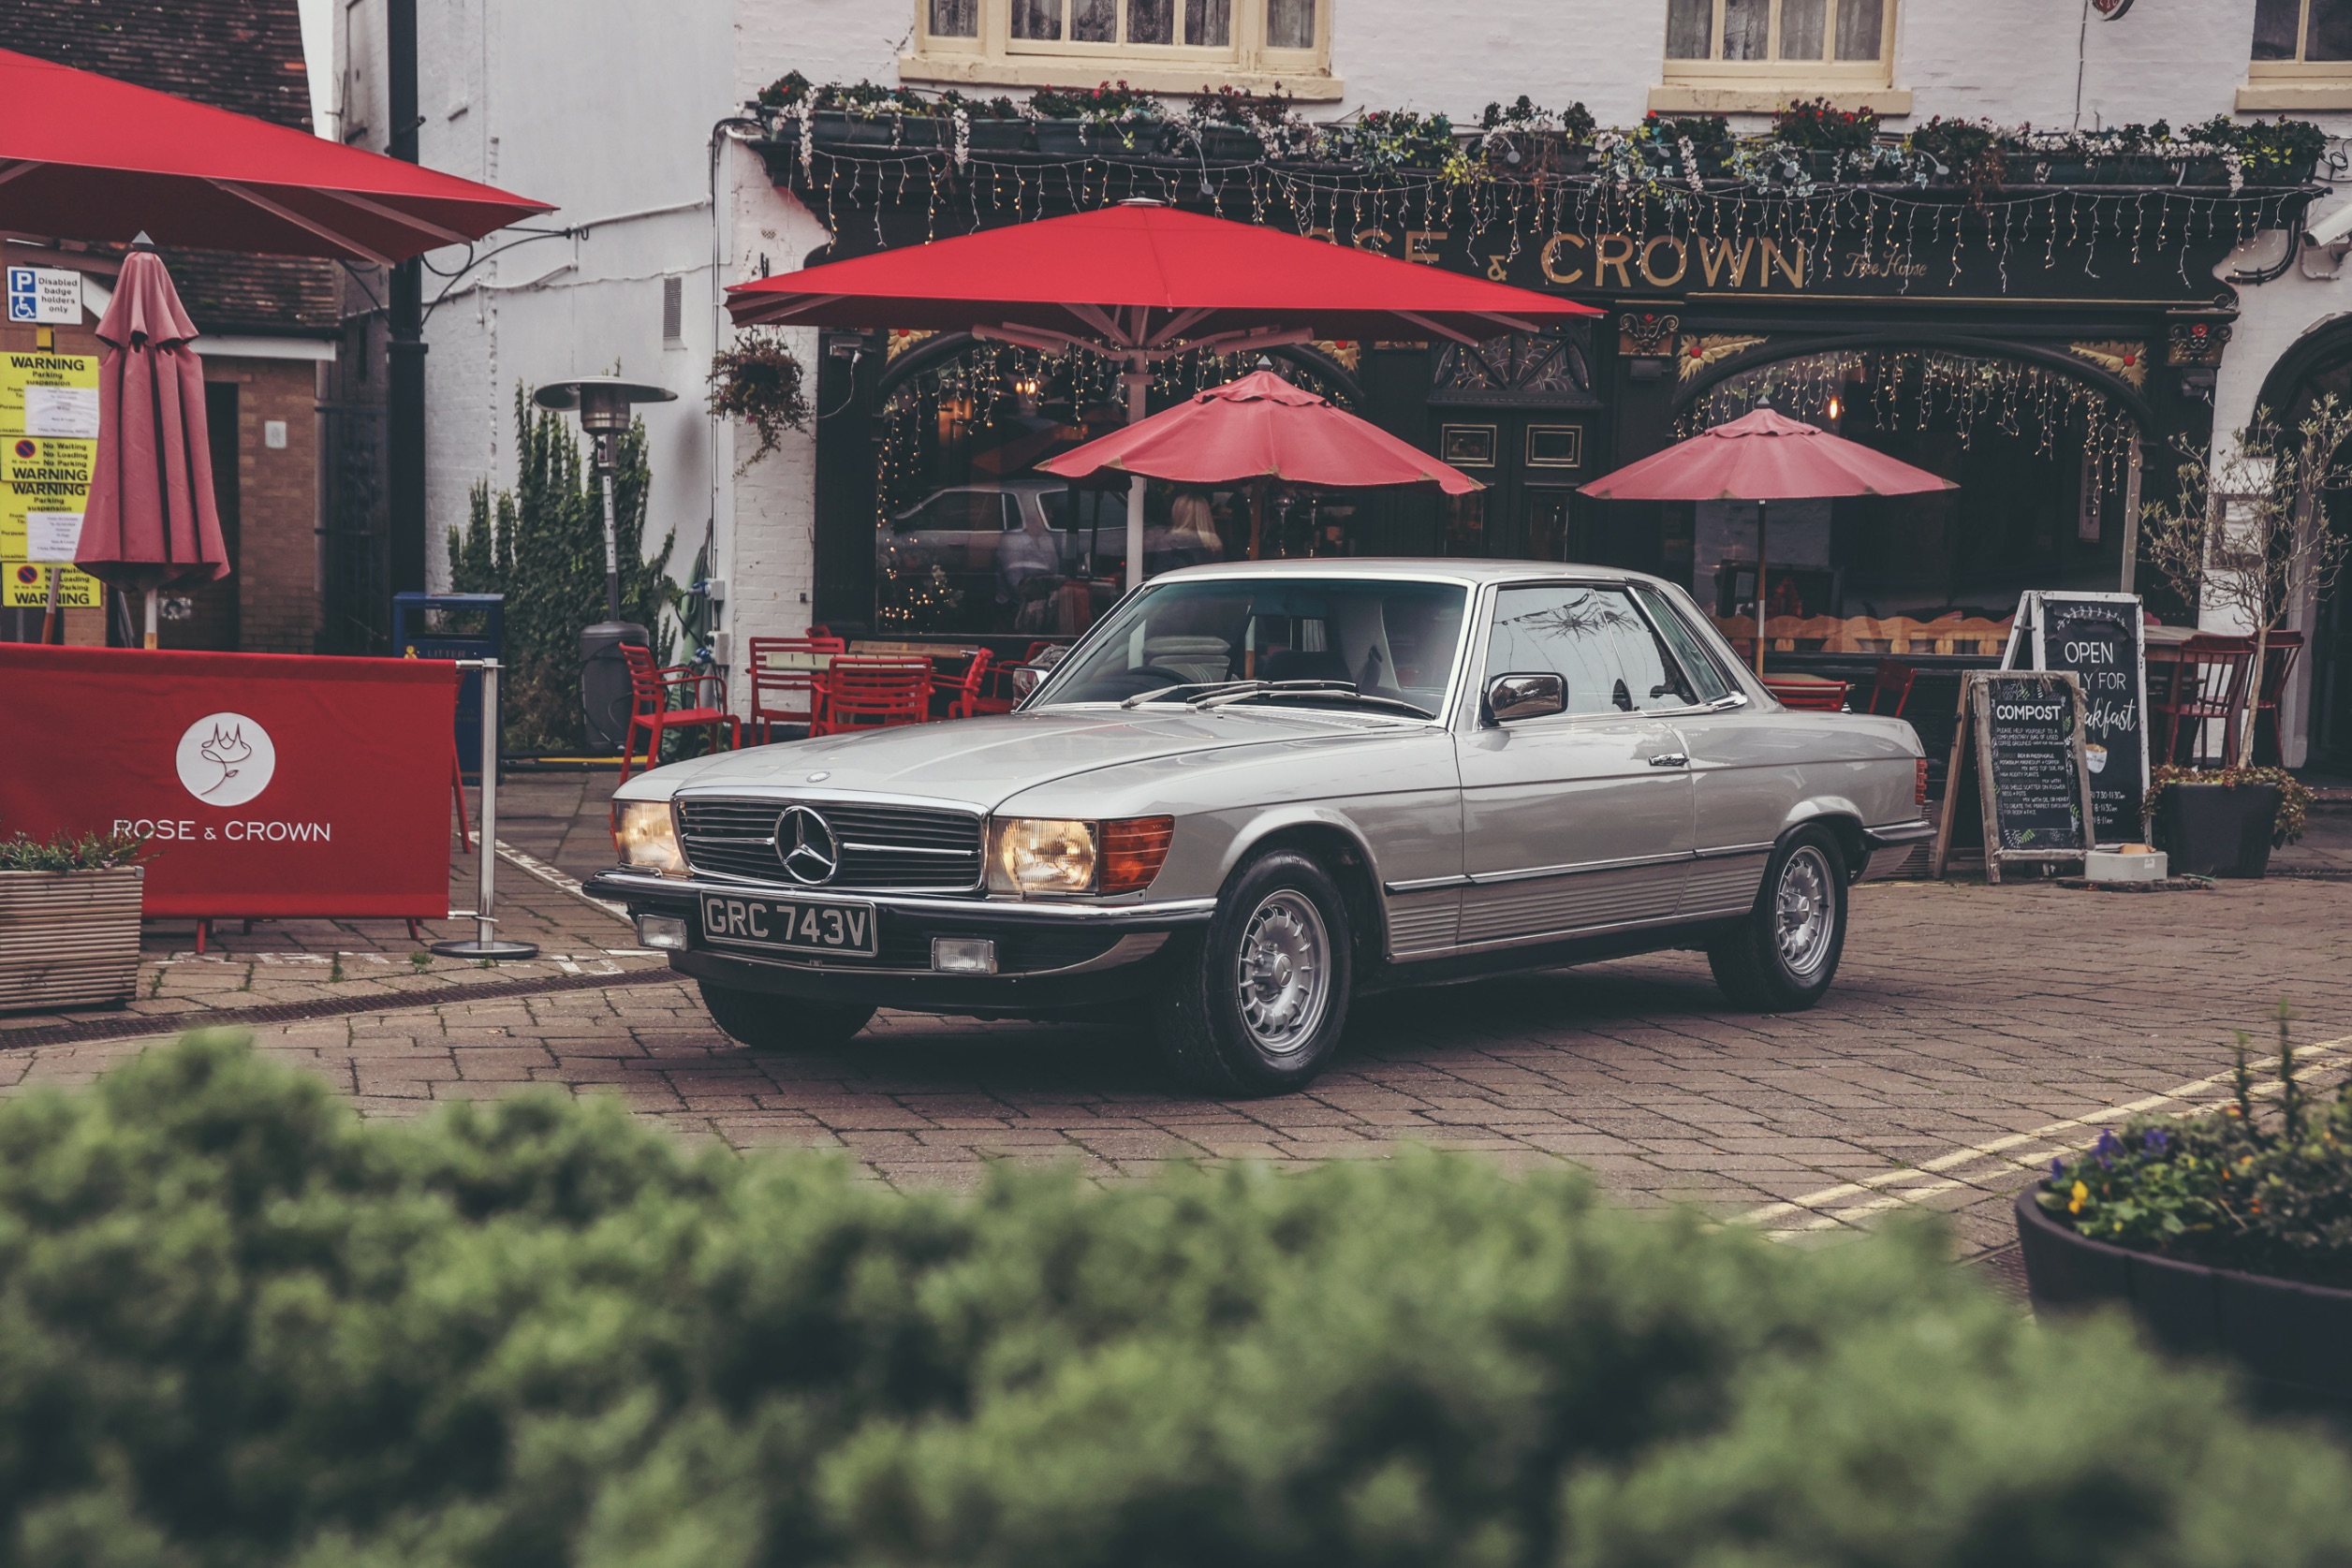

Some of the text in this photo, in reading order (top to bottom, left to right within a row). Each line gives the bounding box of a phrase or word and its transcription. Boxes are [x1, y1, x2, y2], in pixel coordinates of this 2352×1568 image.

[1487, 255, 1507, 281] &
[1540, 233, 1804, 288] CROWN
[1844, 251, 1928, 277] Free House
[38, 277, 78, 286] Disabled
[44, 286, 72, 296] badge
[41, 295, 76, 304] holders
[49, 304, 68, 314] only
[10, 356, 84, 372] WARNING
[32, 371, 63, 379] Parking
[57, 443, 87, 451] Waiting
[57, 460, 87, 468] Parking
[12, 467, 88, 481] WARNING
[11, 482, 86, 496] WARNING
[34, 496, 65, 505] Parking
[427, 650, 465, 658] LITTER
[2065, 641, 2114, 664] OPEN
[2098, 671, 2126, 691] FOR
[1996, 705, 2061, 721] COMPOST
[2084, 696, 2137, 740] akfast
[112, 818, 331, 842] ROSE & CROWN
[707, 898, 865, 946] GRC 743V
